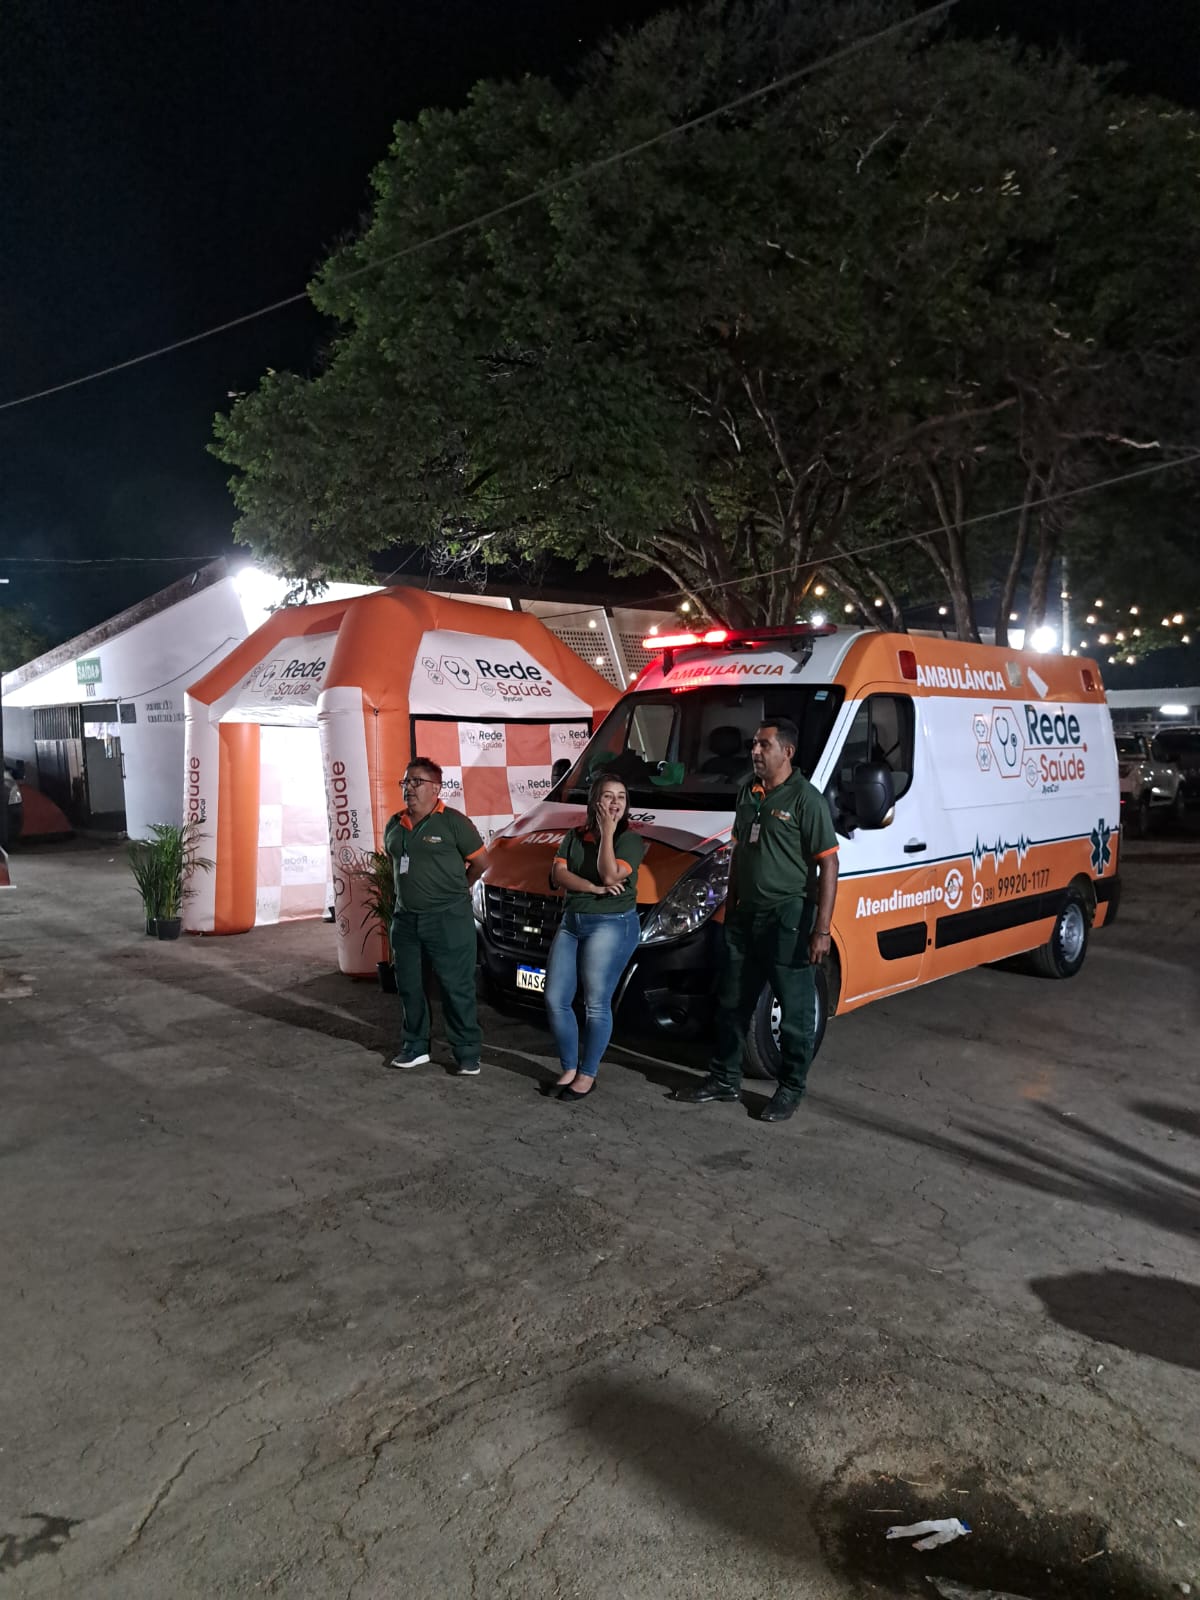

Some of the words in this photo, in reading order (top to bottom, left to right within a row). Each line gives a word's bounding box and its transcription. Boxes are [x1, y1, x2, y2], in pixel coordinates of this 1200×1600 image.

[281, 657, 326, 678] Rede
[475, 659, 542, 681] Rede
[668, 662, 784, 681] AMBULÂNCIA
[916, 663, 1007, 691] AMBULÂNCIA
[274, 681, 311, 696] Saúde
[496, 682, 552, 697] Saúde
[1024, 704, 1081, 745] Rede
[479, 730, 503, 741] Rede
[1040, 751, 1086, 783] Saúde
[441, 778, 460, 789] ede
[527, 778, 551, 789] Rede
[331, 761, 351, 841] Saúde
[351, 809, 360, 839] ByoCol
[998, 868, 1050, 898] 99920-1177
[855, 885, 944, 919] Atendimento
[522, 972, 546, 990] NAS6
